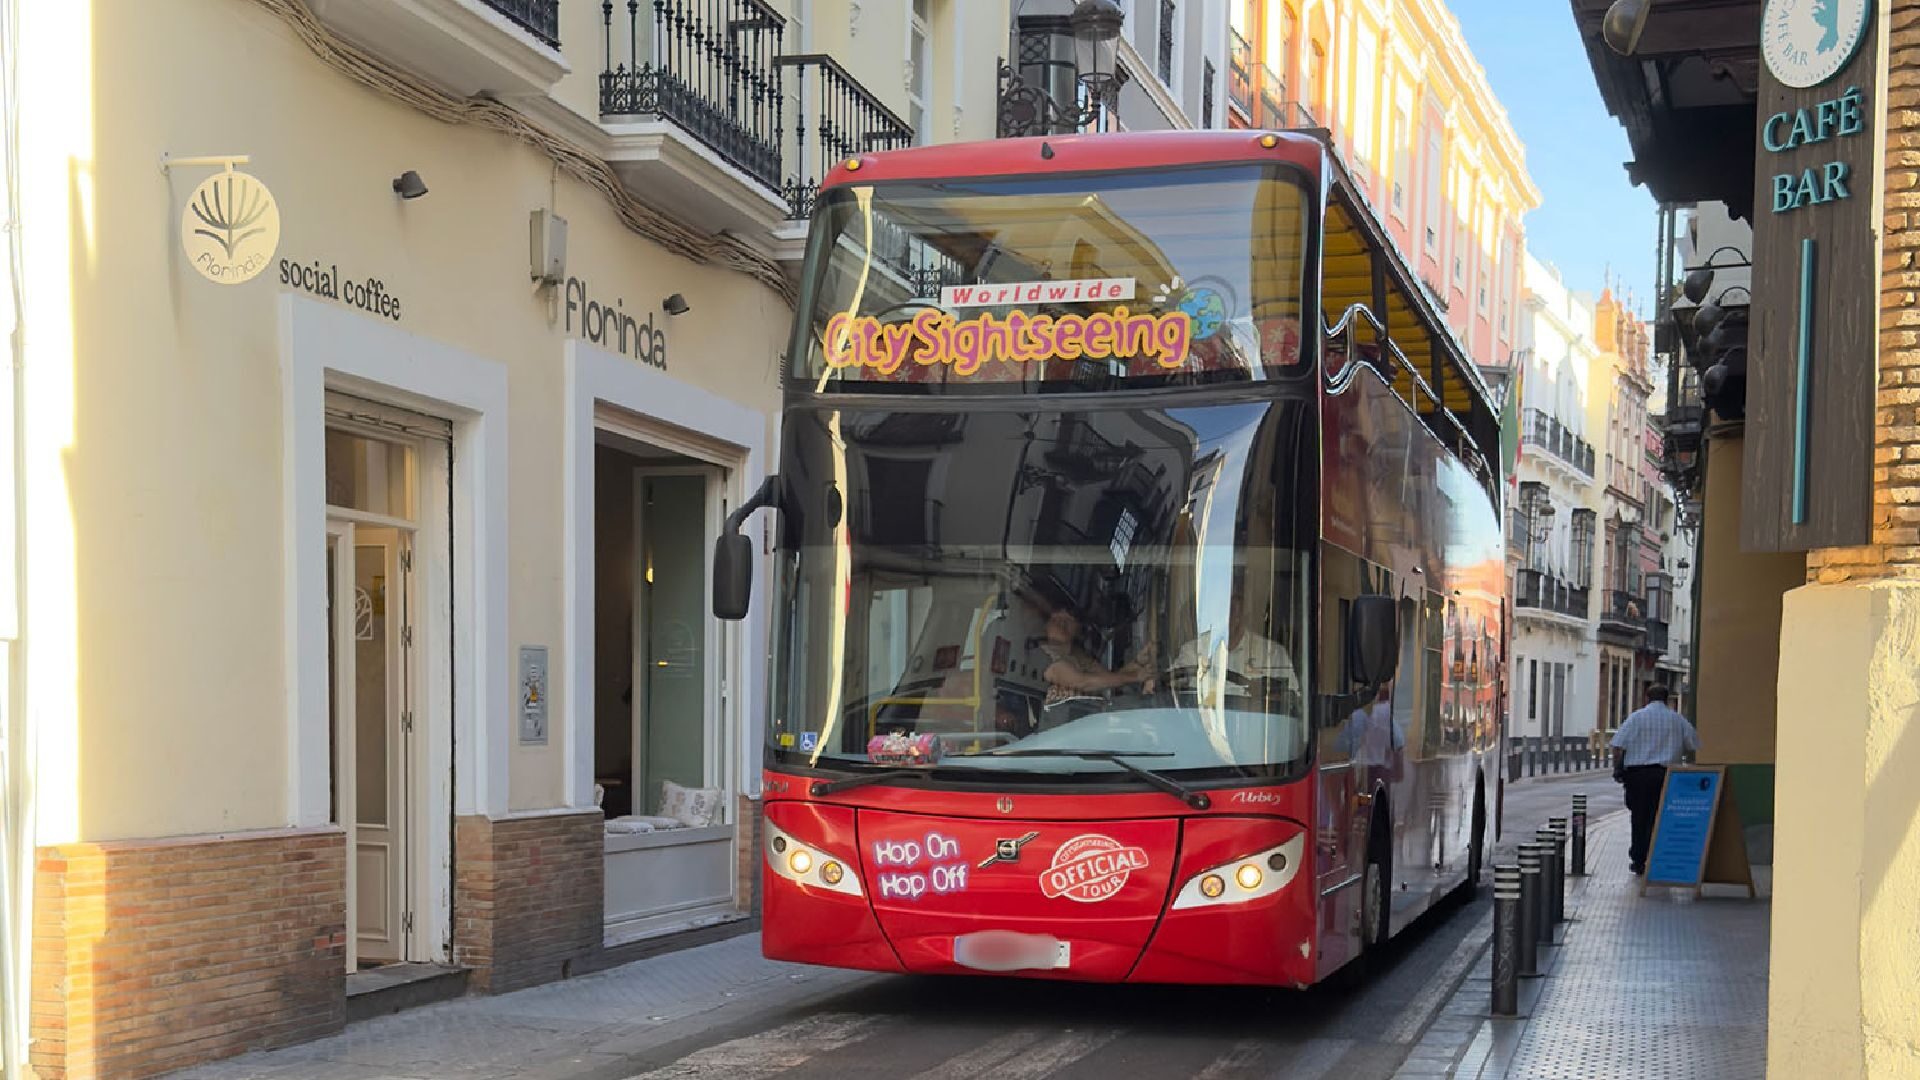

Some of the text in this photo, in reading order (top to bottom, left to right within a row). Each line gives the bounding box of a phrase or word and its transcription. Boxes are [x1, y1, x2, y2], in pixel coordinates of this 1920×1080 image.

[1783, 42, 1807, 65] BAR
[1762, 86, 1864, 152] CAFÉ
[1771, 161, 1849, 213] BAR
[279, 257, 401, 321] social coffee
[952, 281, 1124, 305] Worldwide
[565, 276, 668, 371] florinda
[826, 307, 1190, 375] CitySightseeing
[875, 832, 958, 865] Hop On
[881, 865, 966, 897] Hop Off
[1051, 850, 1141, 890] OFFICIAL
[1082, 876, 1122, 897] TOUR
